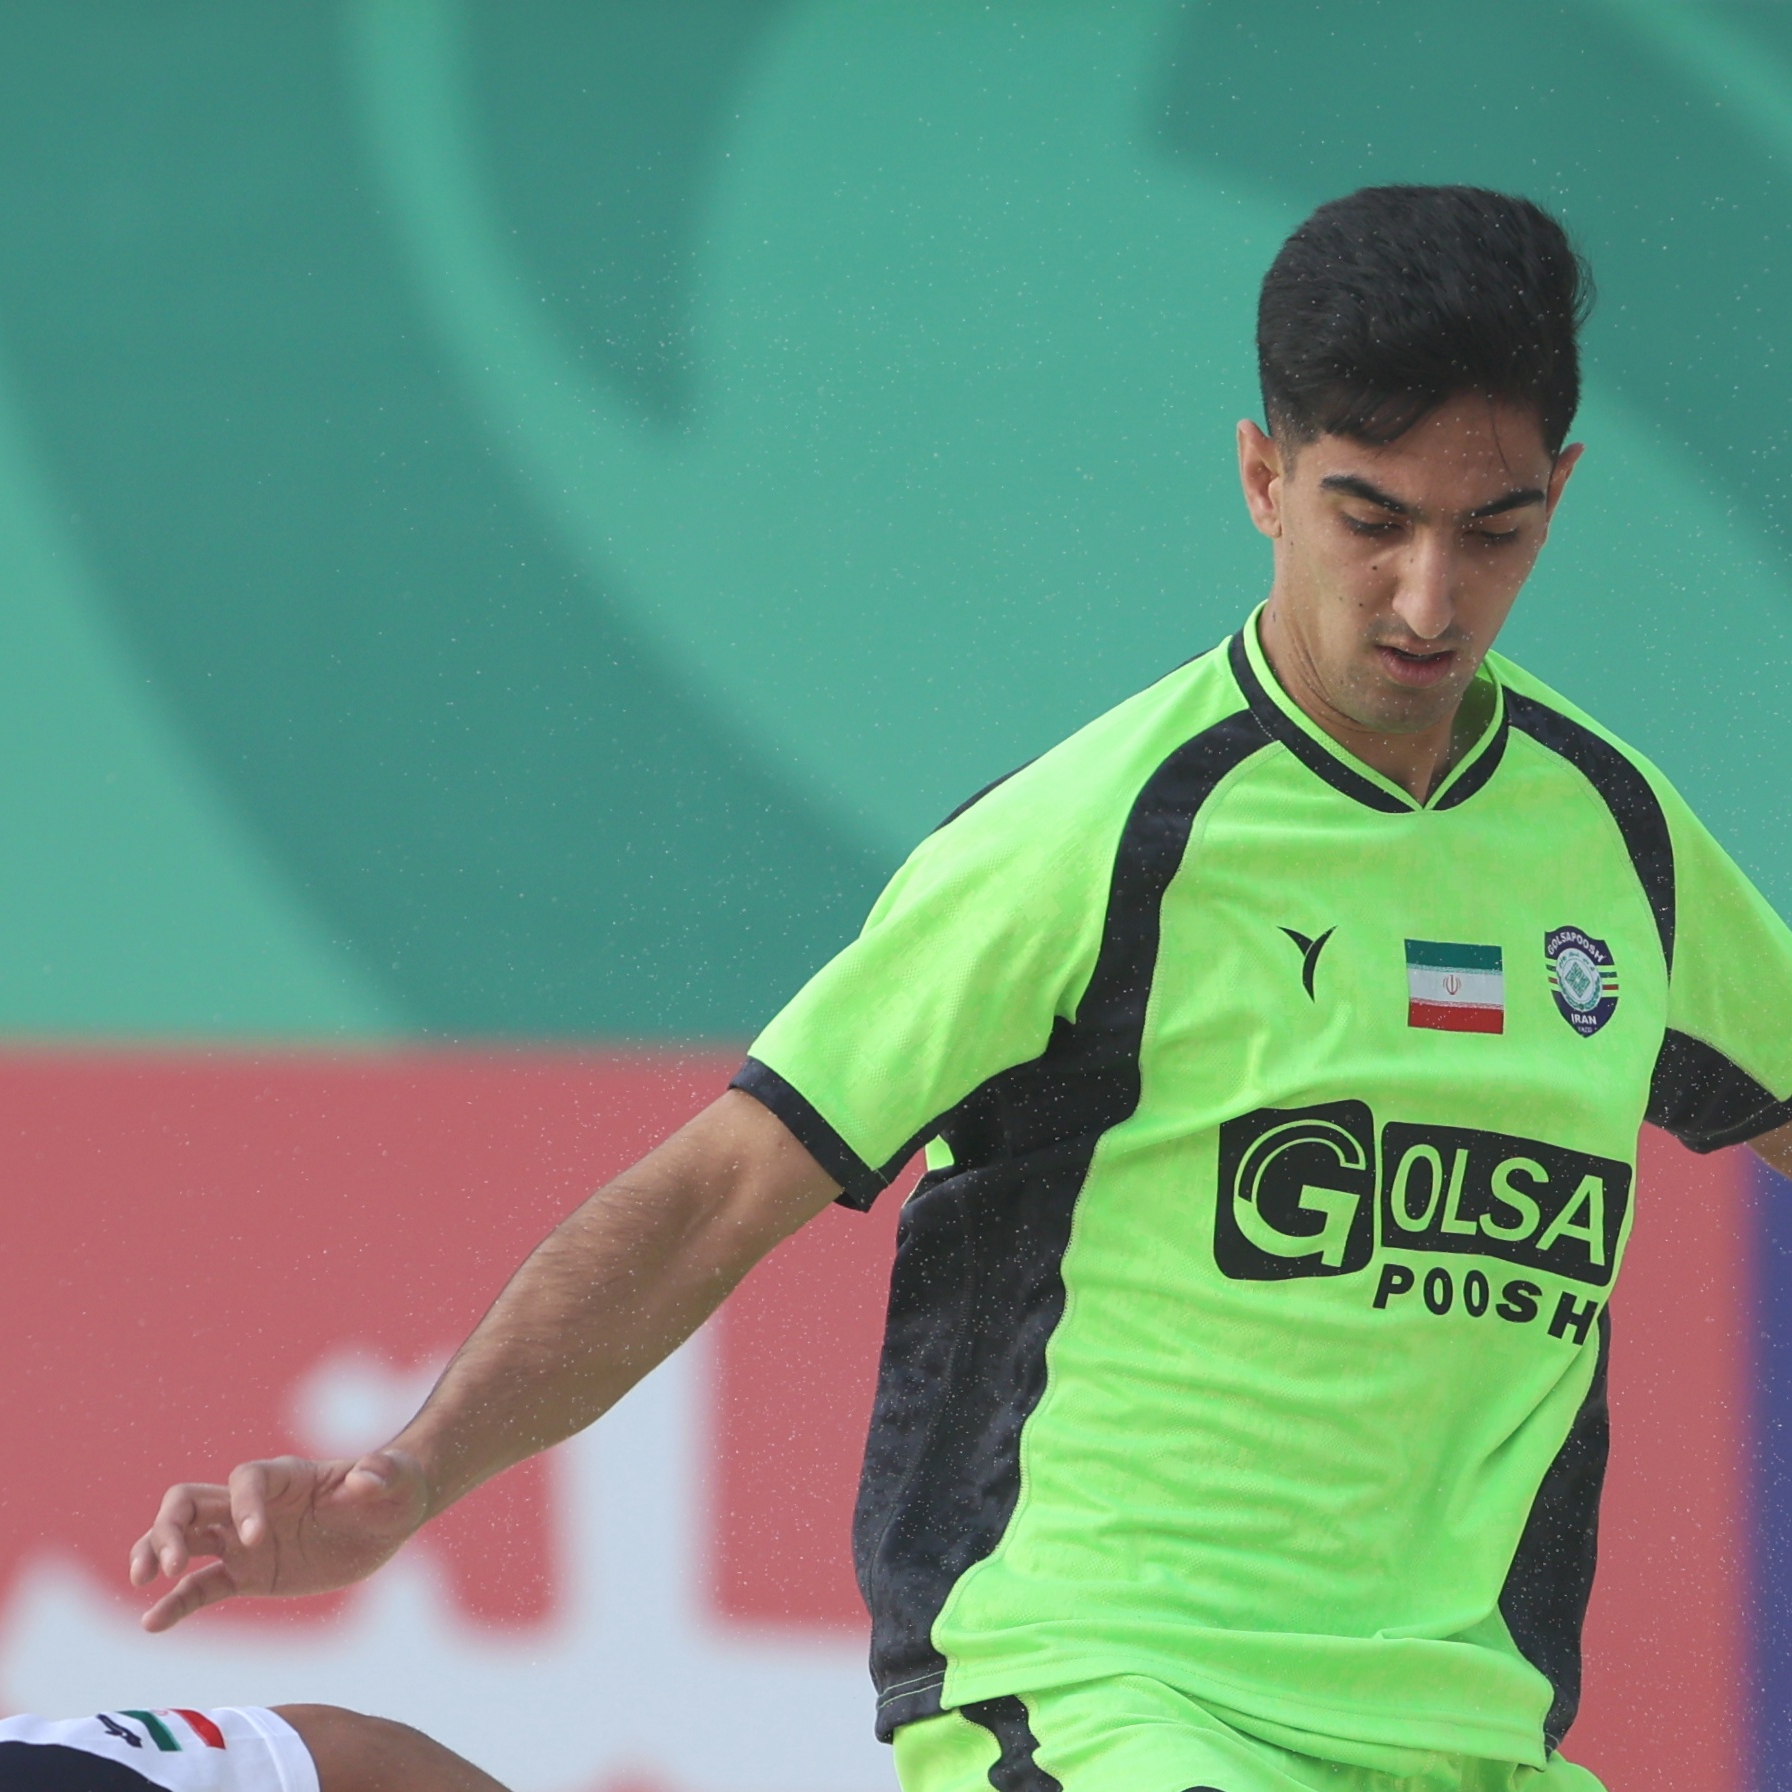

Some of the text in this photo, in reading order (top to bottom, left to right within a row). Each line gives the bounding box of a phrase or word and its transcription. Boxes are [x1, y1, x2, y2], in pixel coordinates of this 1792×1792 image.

[1547, 931, 1605, 963] GOLSAPOOSH
[1571, 1013, 1597, 1026] IRAN
[1232, 1117, 1605, 1269] GOLSA
[1372, 1262, 1599, 1347] POOSH
